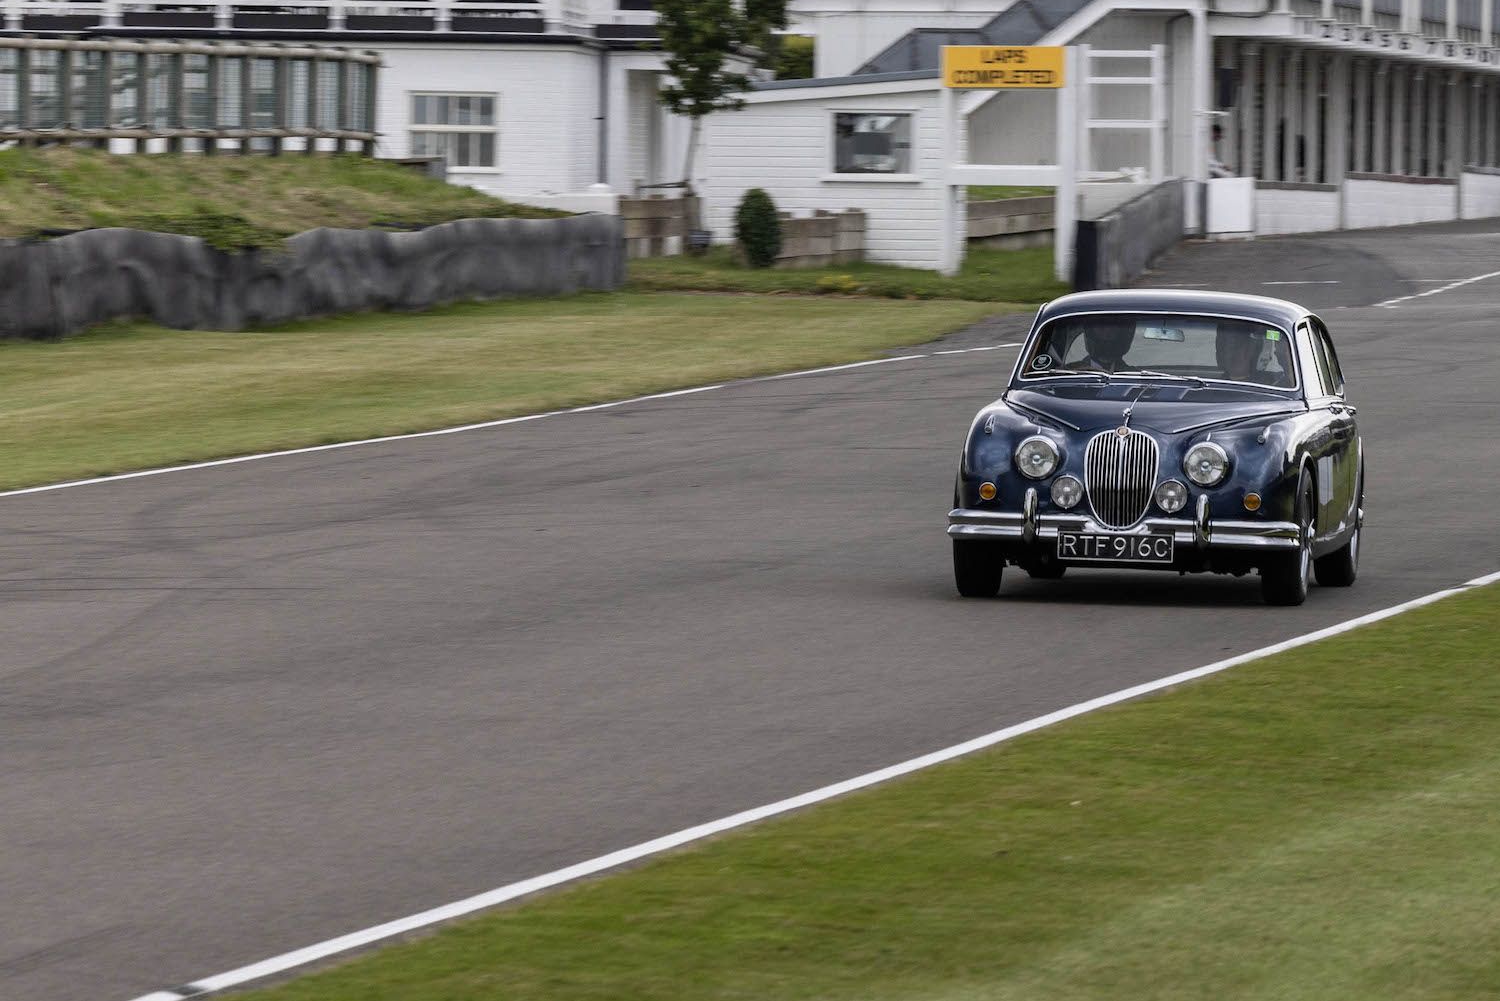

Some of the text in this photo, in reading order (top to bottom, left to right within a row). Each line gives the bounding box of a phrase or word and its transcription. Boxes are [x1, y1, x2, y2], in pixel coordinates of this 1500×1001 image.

[980, 49, 1028, 64] LAPS
[952, 69, 1057, 85] COMPLETED
[1062, 534, 1169, 558] RTF916C
